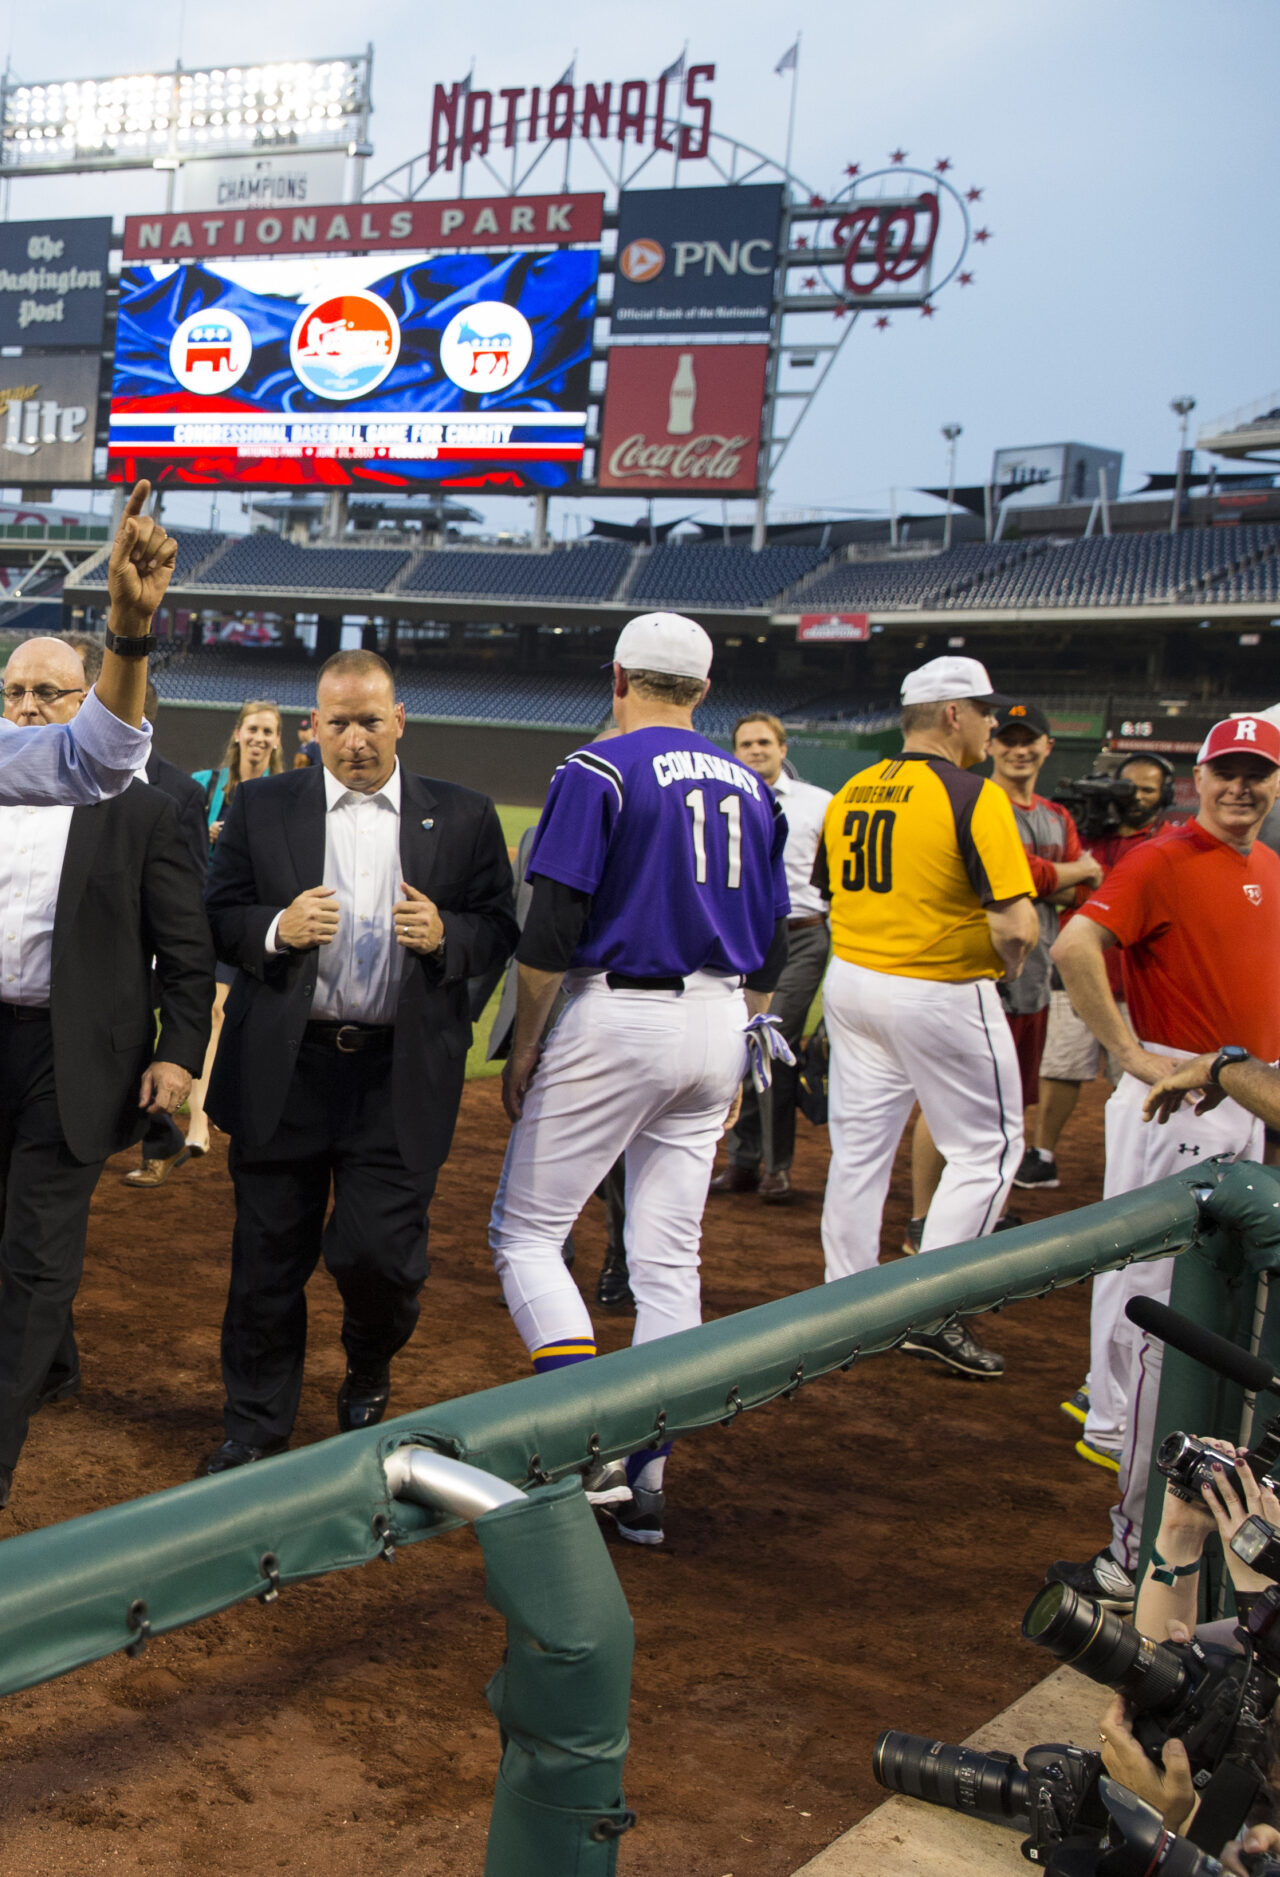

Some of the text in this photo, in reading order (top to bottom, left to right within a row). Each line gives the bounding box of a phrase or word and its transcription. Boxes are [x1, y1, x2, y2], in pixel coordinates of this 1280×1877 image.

[429, 64, 715, 173] NATIONALS
[217, 176, 308, 204] CHAMPIONS
[27, 235, 64, 262] The
[138, 204, 573, 249] NATIONALS PARK
[672, 239, 773, 277] PNC
[18, 299, 64, 329] Post
[2, 399, 88, 456] Lite
[173, 424, 514, 443] CONGRESSIONAL BASEBALL GAME FOR CHARITY
[609, 434, 752, 479] Coca-Cola
[1233, 719, 1257, 742] R
[652, 751, 761, 802] CONAWAY
[685, 788, 742, 889] 11
[842, 810, 896, 893] 30
